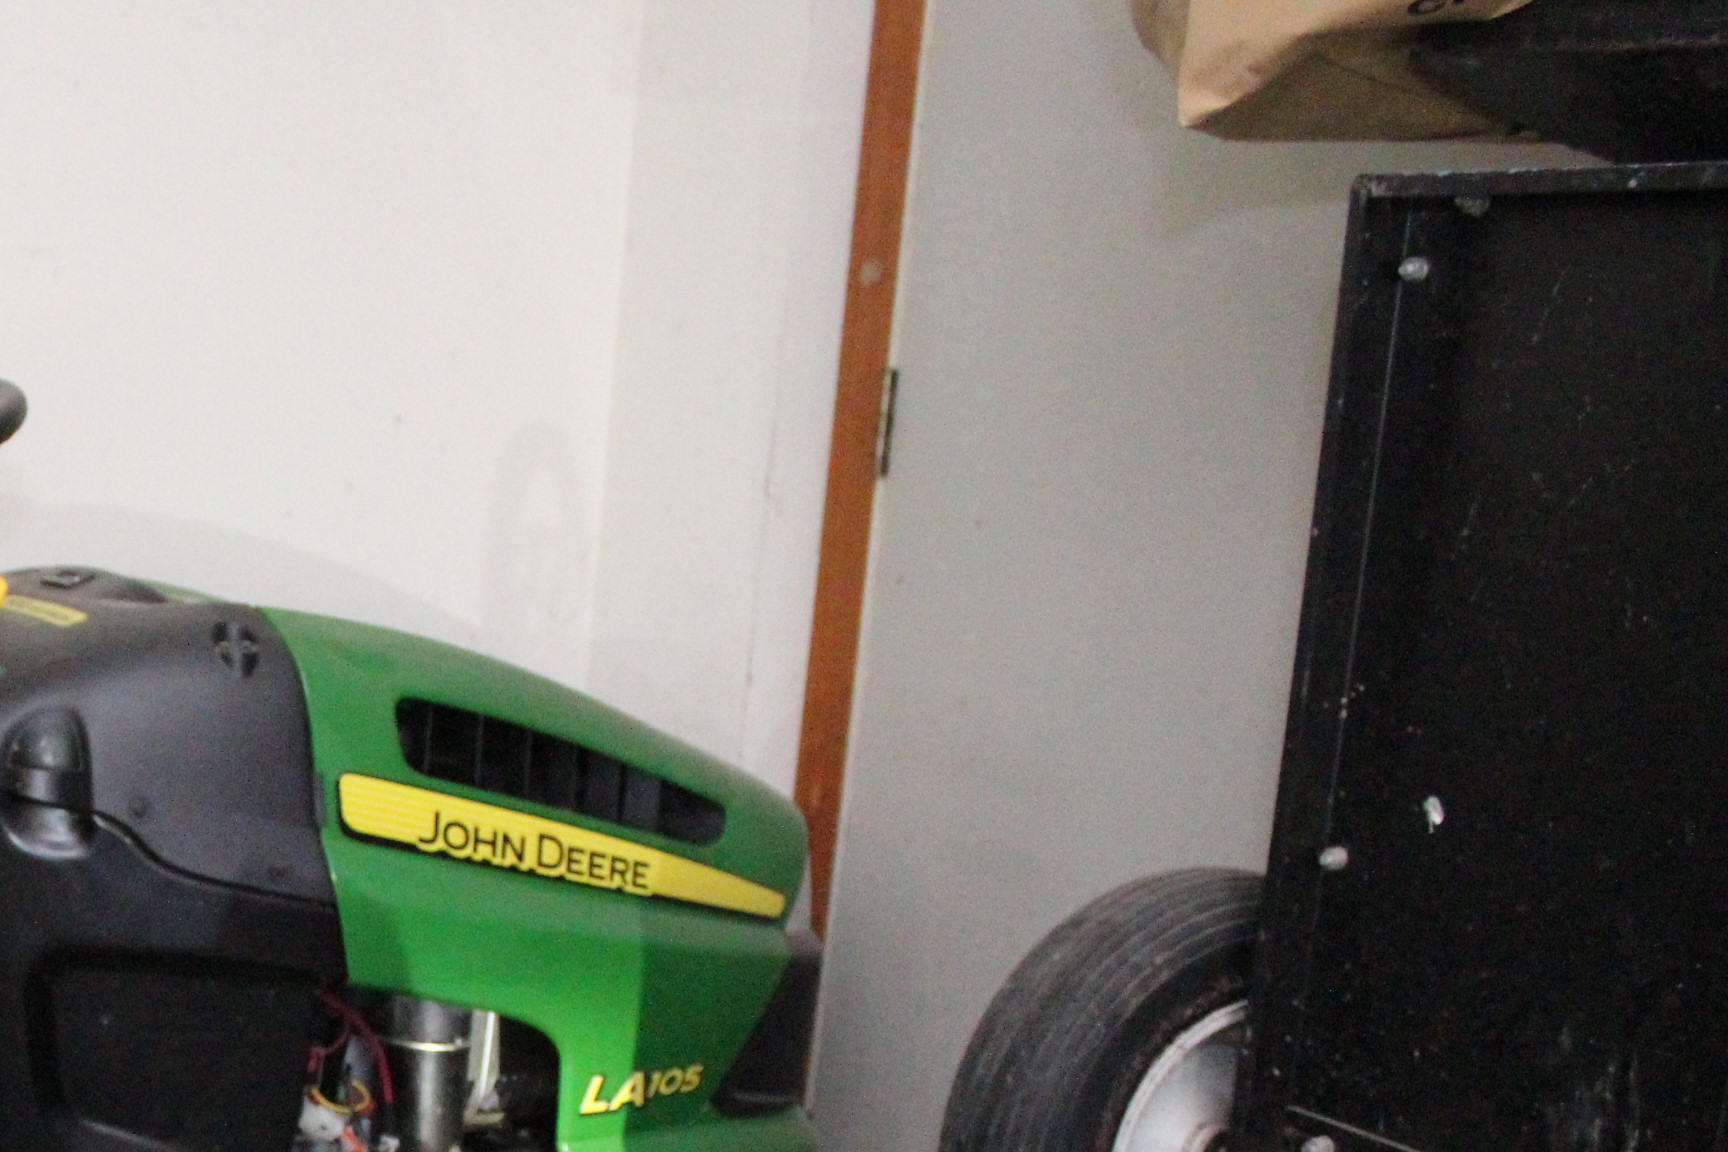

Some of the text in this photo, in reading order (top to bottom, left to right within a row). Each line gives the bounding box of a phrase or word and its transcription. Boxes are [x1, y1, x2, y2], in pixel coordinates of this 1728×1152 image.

[418, 810, 650, 889] JOHN DEERE
[579, 1063, 704, 1115] LA105
